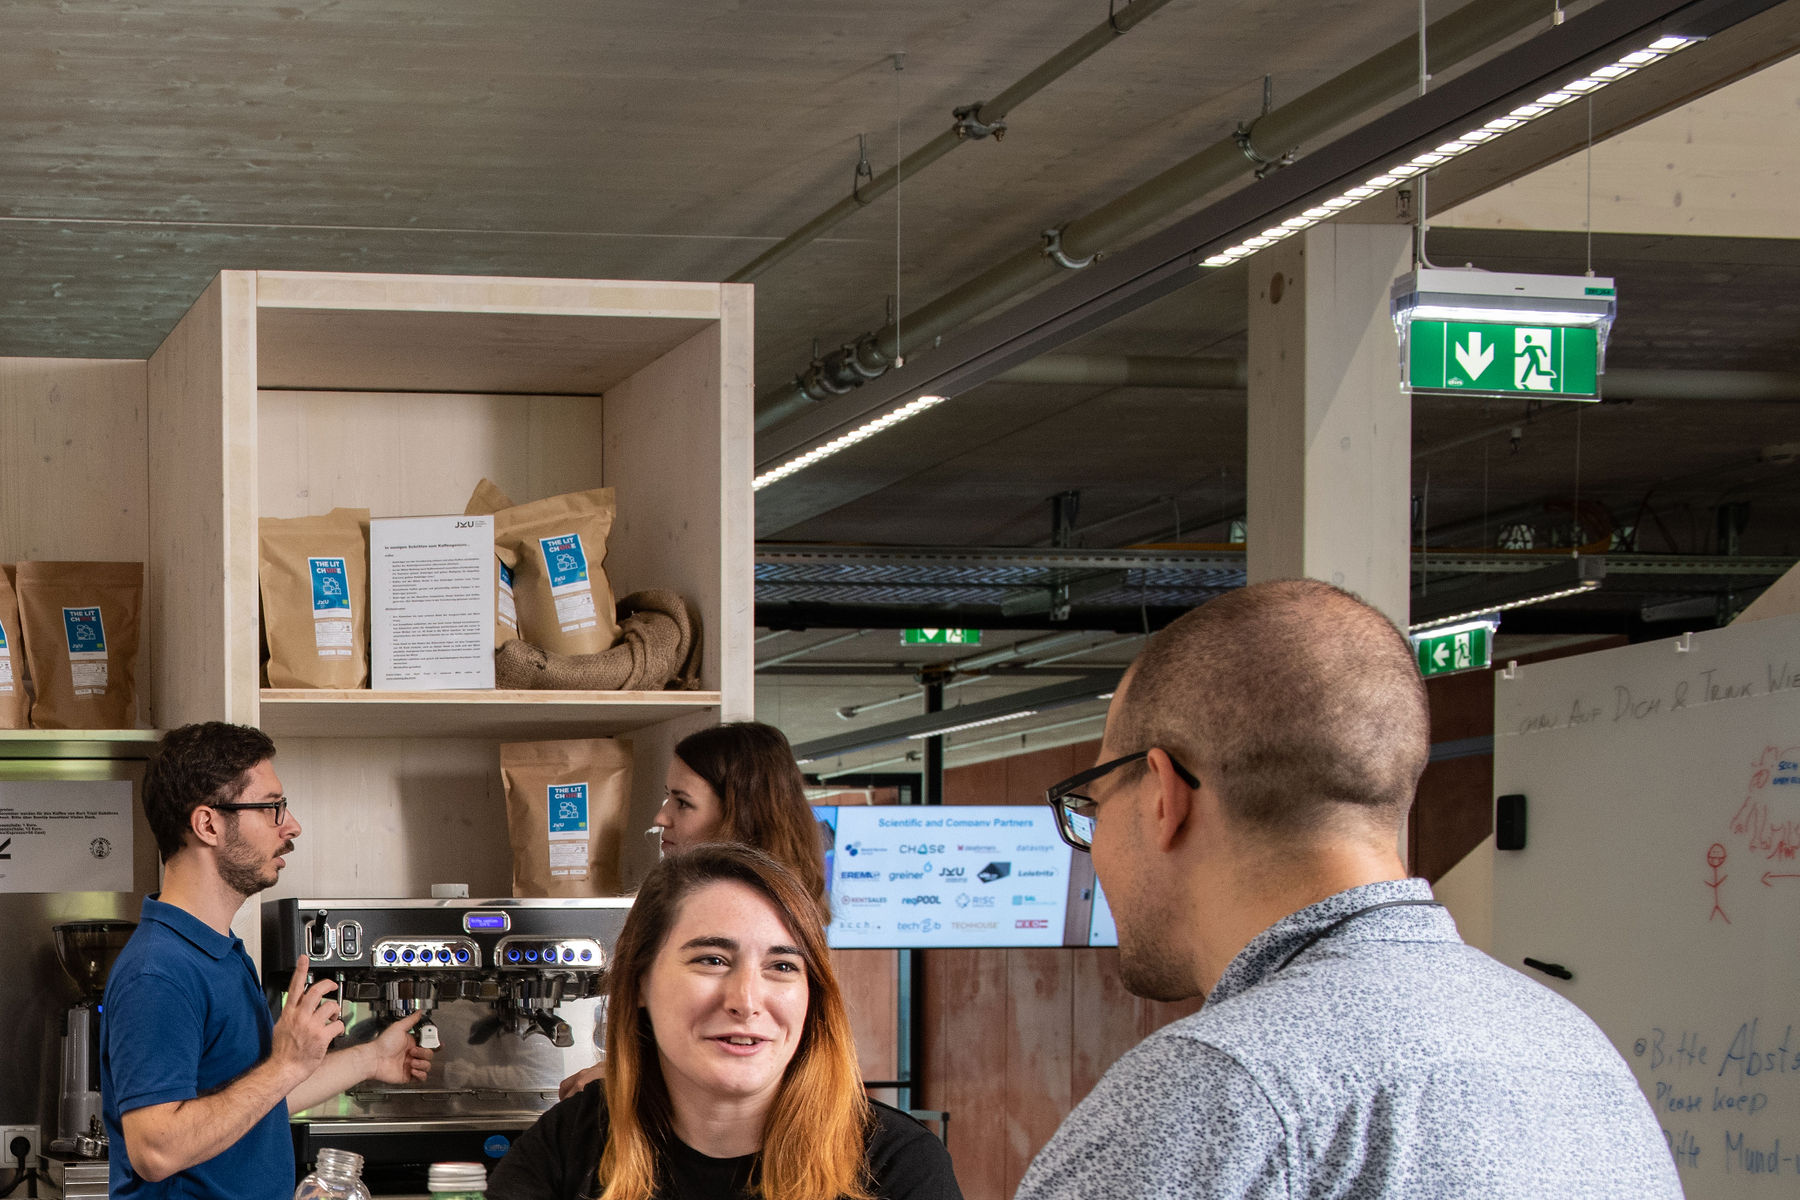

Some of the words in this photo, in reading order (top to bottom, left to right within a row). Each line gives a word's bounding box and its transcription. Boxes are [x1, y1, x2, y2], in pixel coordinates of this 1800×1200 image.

[879, 818, 922, 828] Scientific
[925, 818, 943, 827] and
[946, 818, 990, 828] Company
[993, 818, 1034, 827] Partners
[888, 870, 924, 882] greiner
